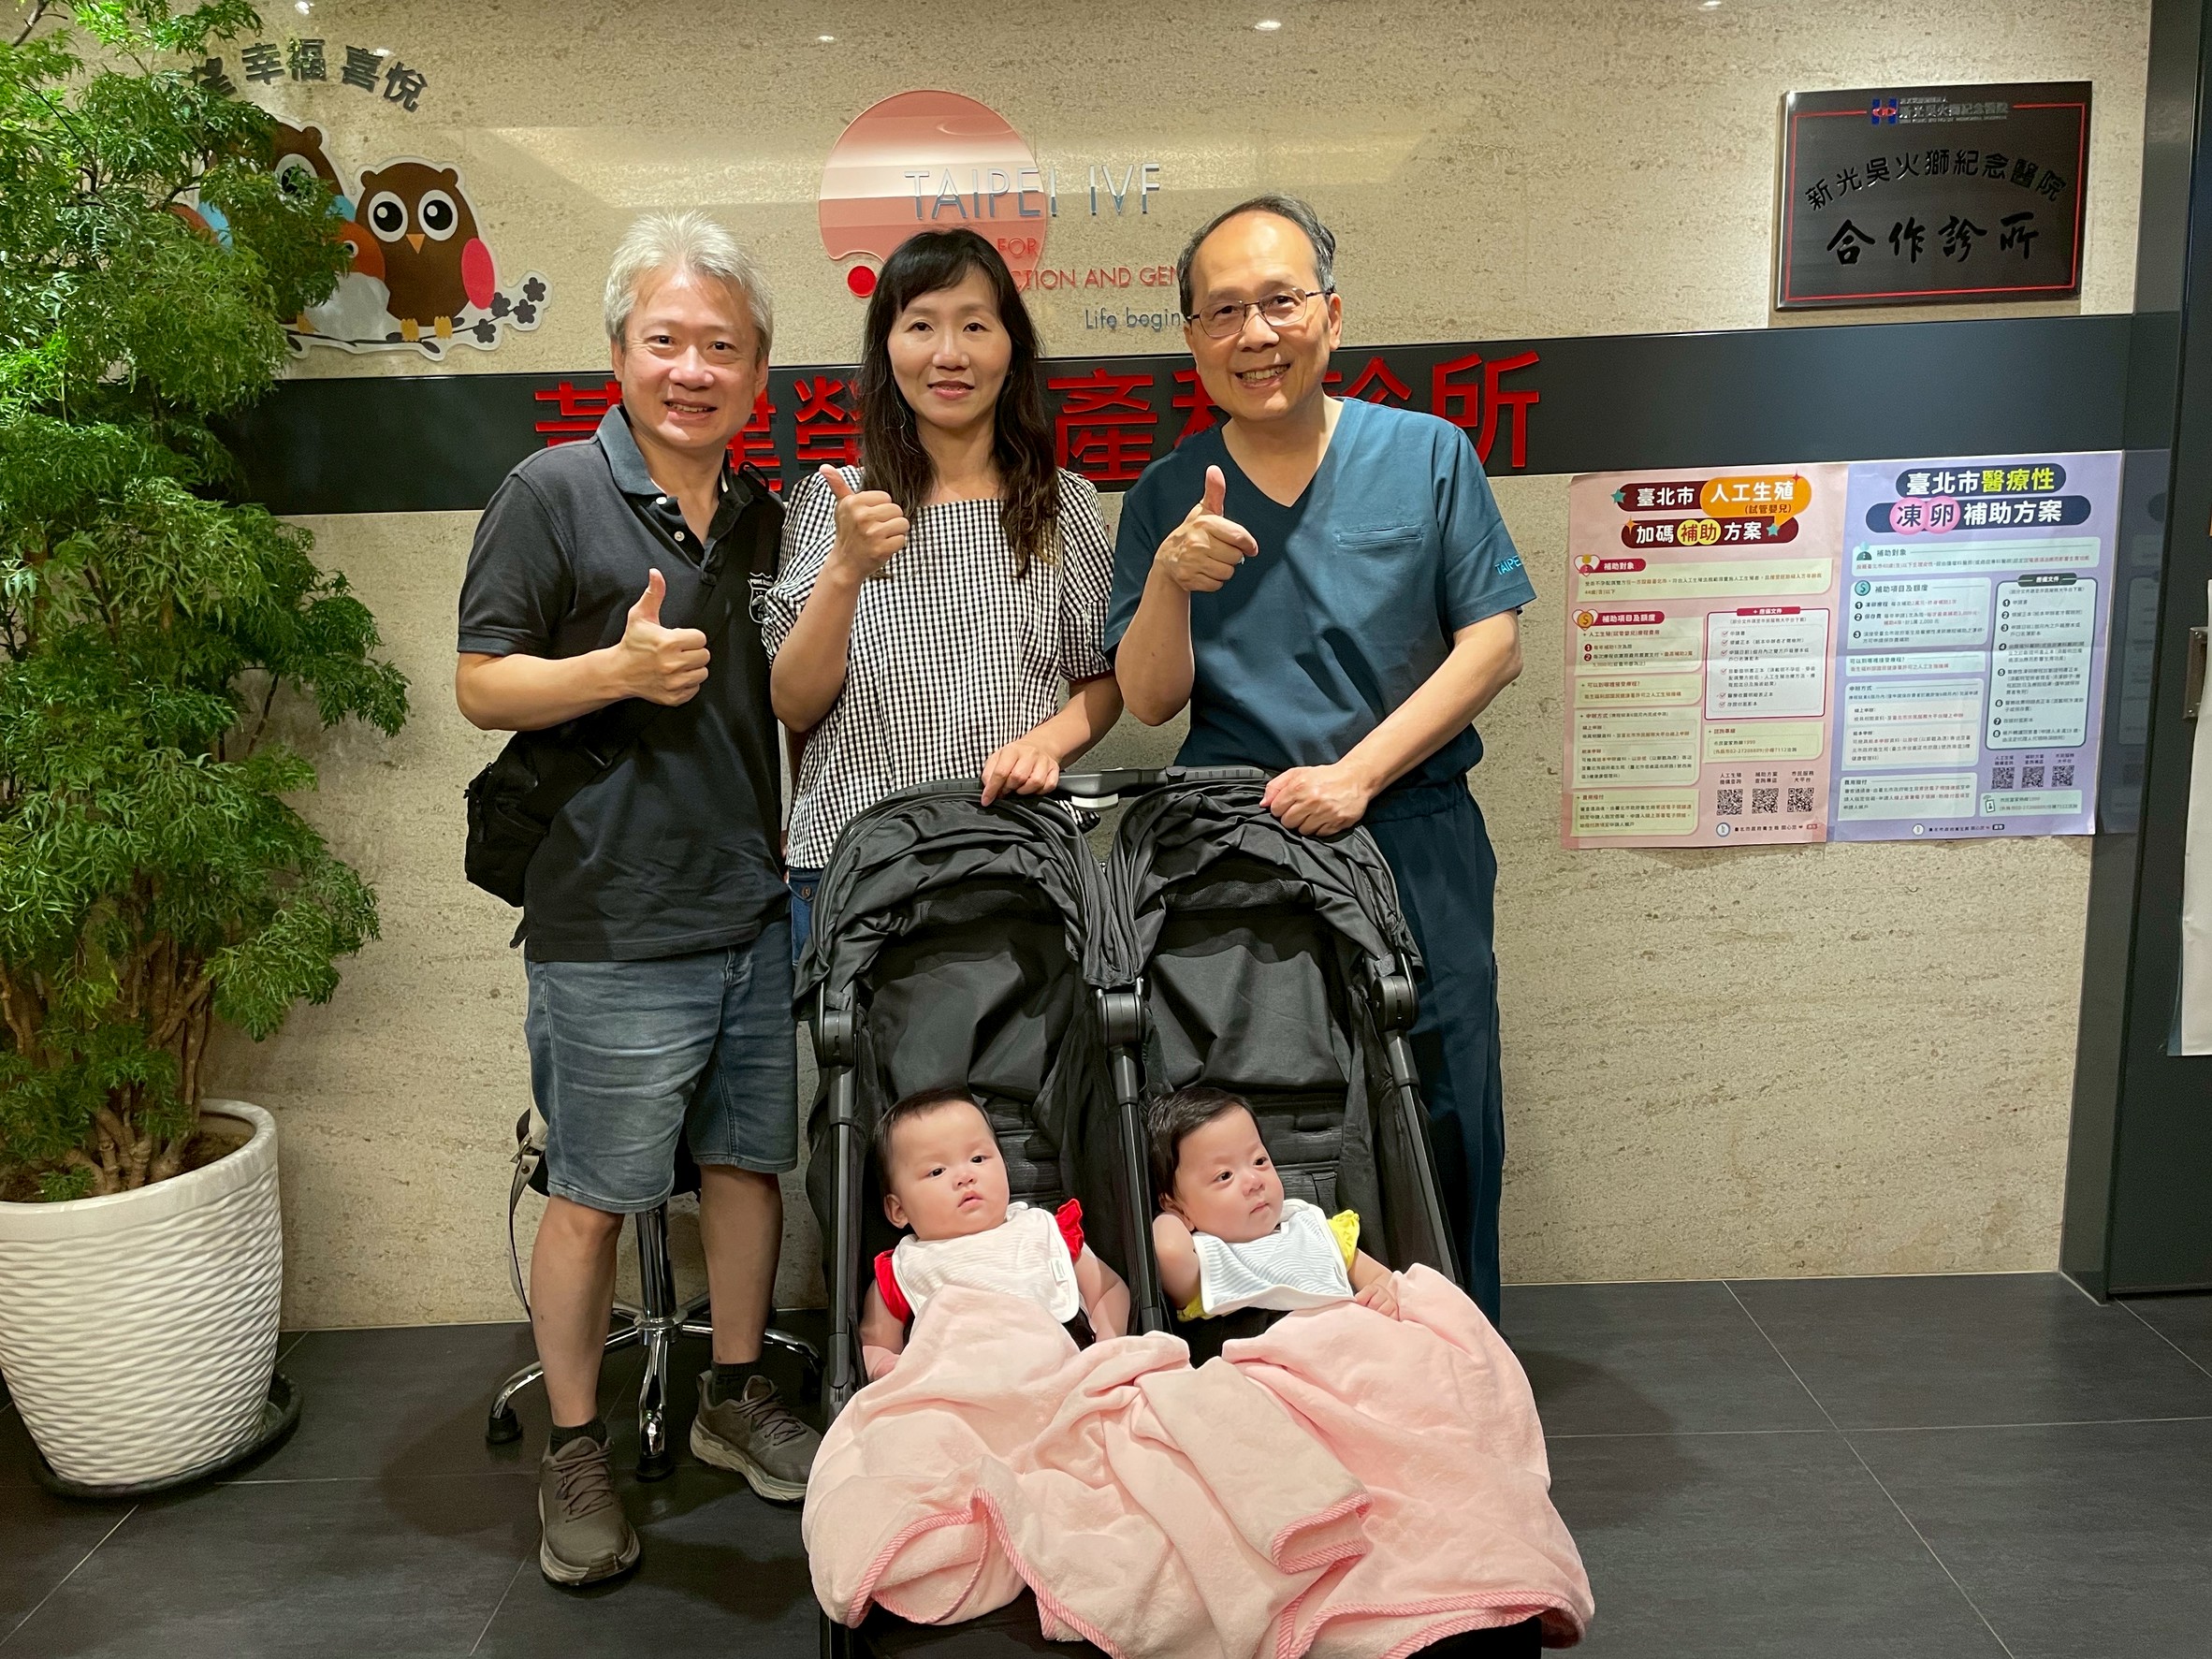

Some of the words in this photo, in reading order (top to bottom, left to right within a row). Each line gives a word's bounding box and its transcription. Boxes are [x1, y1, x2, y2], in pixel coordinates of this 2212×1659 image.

[904, 167, 1057, 219] TAIPEI
[1090, 163, 1160, 216] IVF
[1804, 149, 2067, 211] 新光吳火獅紀念醫院
[997, 237, 1038, 258] FOR
[1826, 211, 2040, 266] 合作診所
[1084, 266, 1132, 288] AND
[1085, 307, 1117, 330] Life
[1126, 306, 1186, 332] begin
[1637, 487, 1695, 507] 臺北市
[1710, 481, 1795, 503] 人工生殖
[1906, 467, 2056, 496] 臺北市醫療性
[1896, 500, 2063, 528] 凍卵補助方案
[1636, 521, 1762, 544] 加碼補助方案
